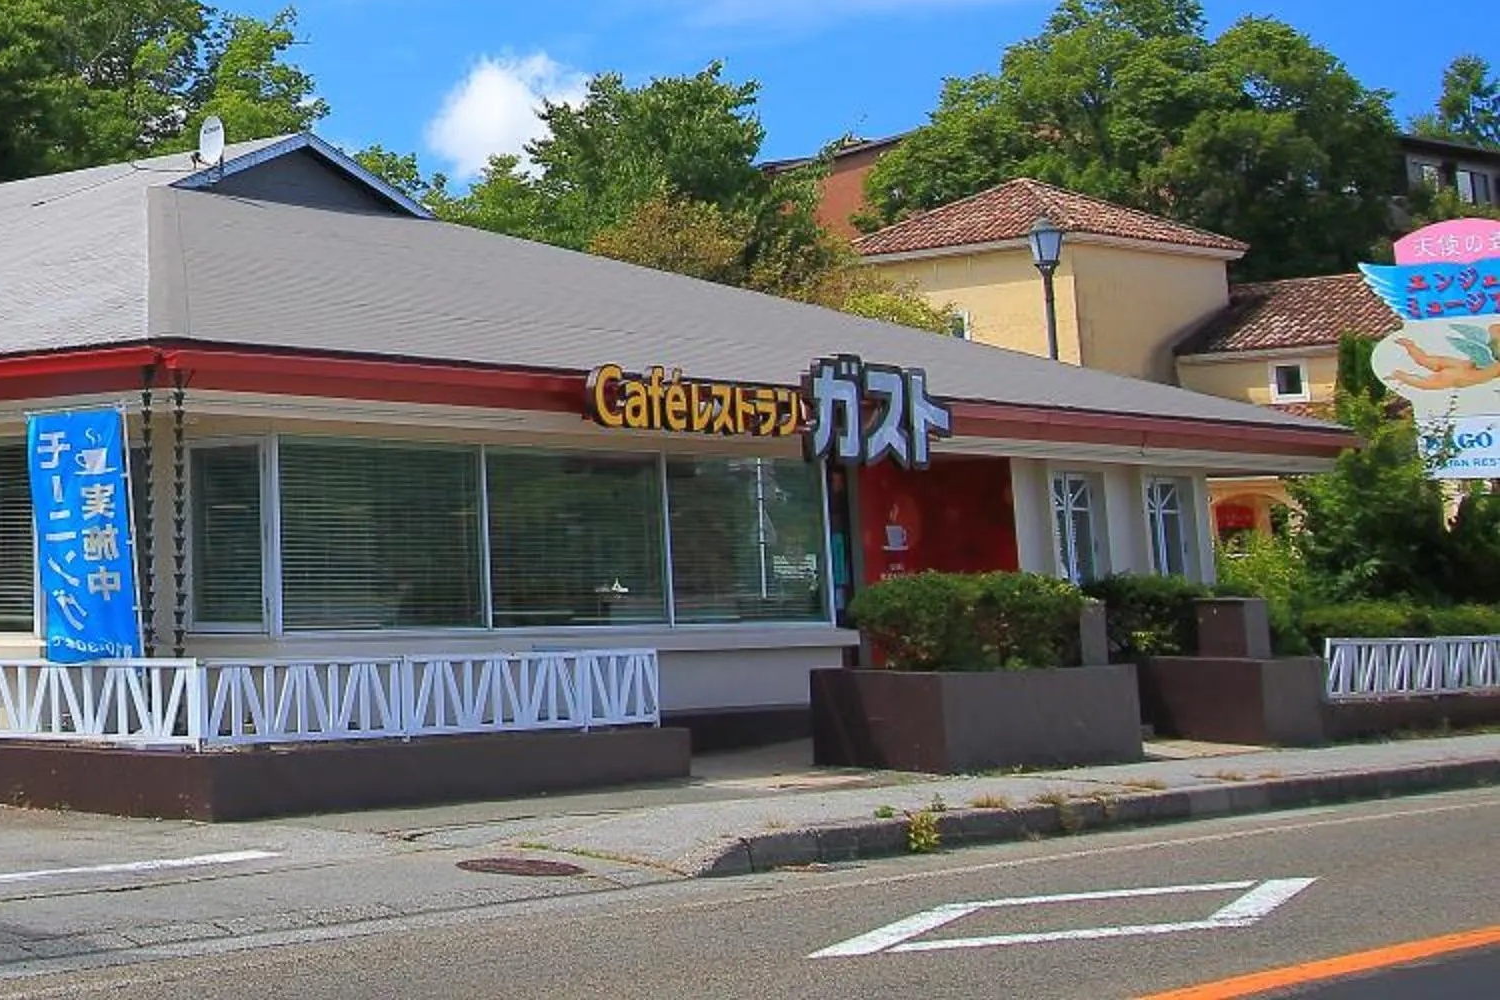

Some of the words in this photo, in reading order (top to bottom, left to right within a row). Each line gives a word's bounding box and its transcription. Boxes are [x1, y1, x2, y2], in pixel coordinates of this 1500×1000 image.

[593, 363, 798, 437] Caféレストラン
[812, 357, 951, 467] ガスト
